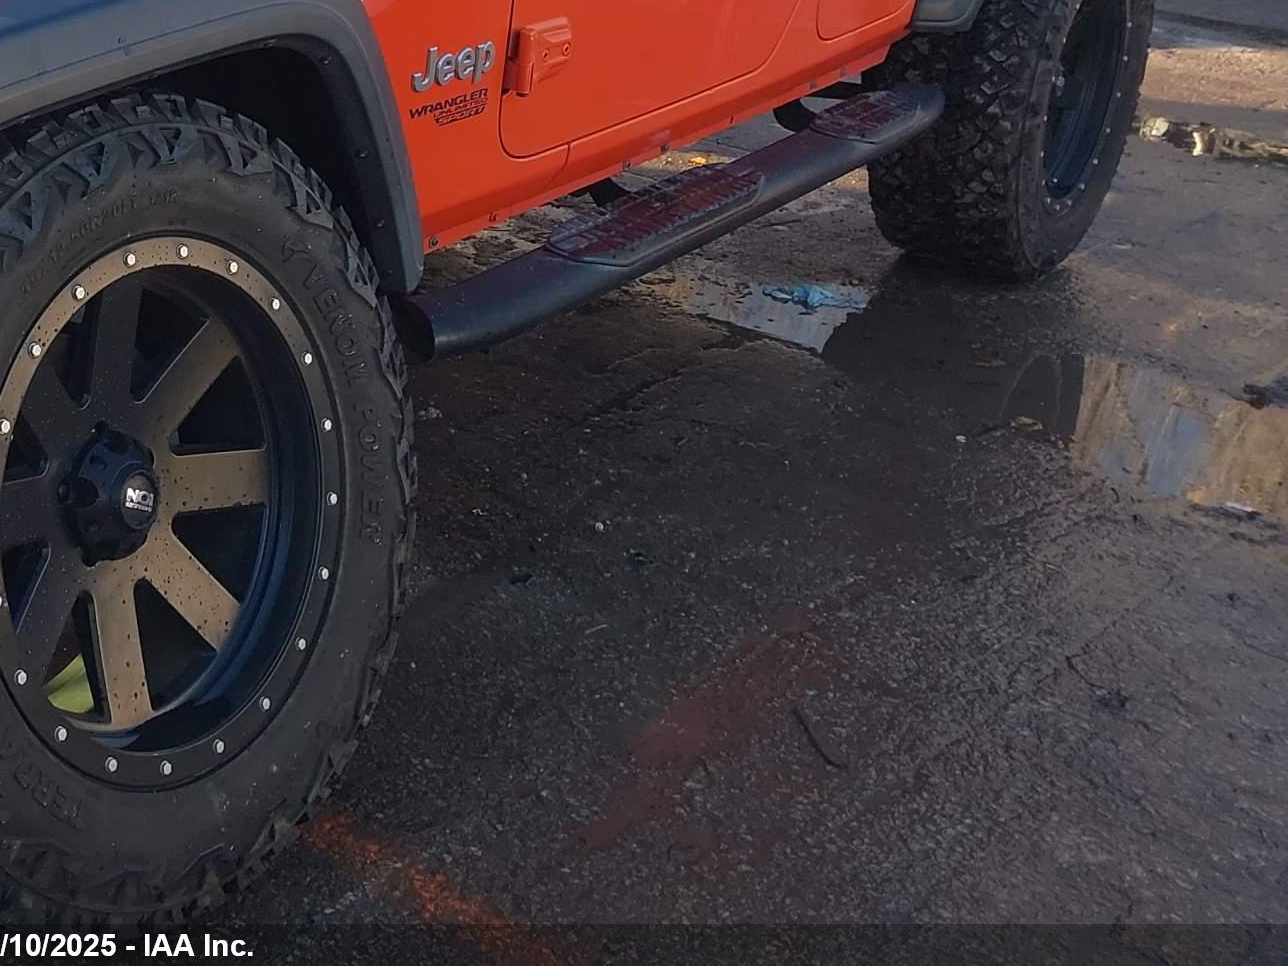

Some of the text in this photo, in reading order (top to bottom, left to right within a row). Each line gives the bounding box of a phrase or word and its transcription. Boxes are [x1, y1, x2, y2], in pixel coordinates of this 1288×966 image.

[411, 41, 496, 93] Jeep
[409, 88, 489, 119] WRANGLER
[304, 262, 385, 546] VENOM POWER
